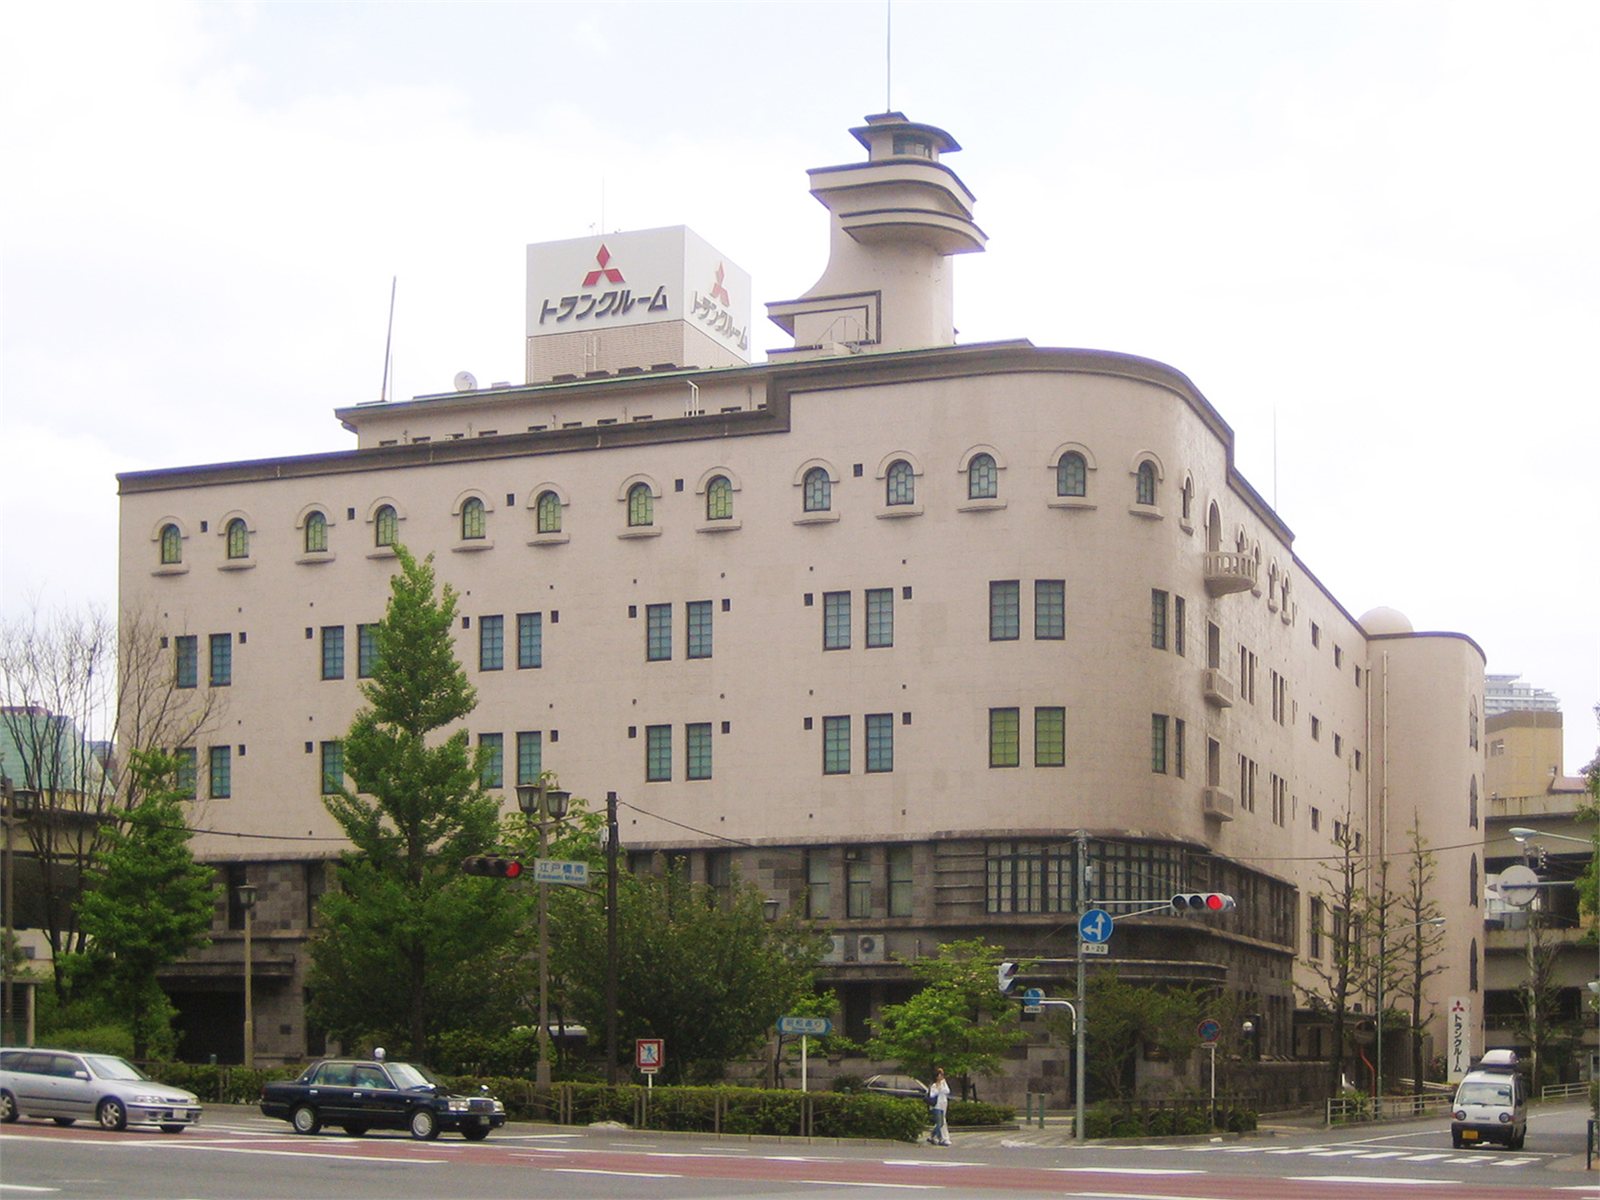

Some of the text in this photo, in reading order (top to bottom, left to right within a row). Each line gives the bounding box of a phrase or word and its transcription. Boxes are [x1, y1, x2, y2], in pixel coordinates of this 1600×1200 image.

[539, 285, 668, 325] トランクルーム
[691, 290, 748, 351] トランクルーム
[539, 862, 585, 875] 江戸橋南
[1453, 1014, 1462, 1072] トランクルーム
